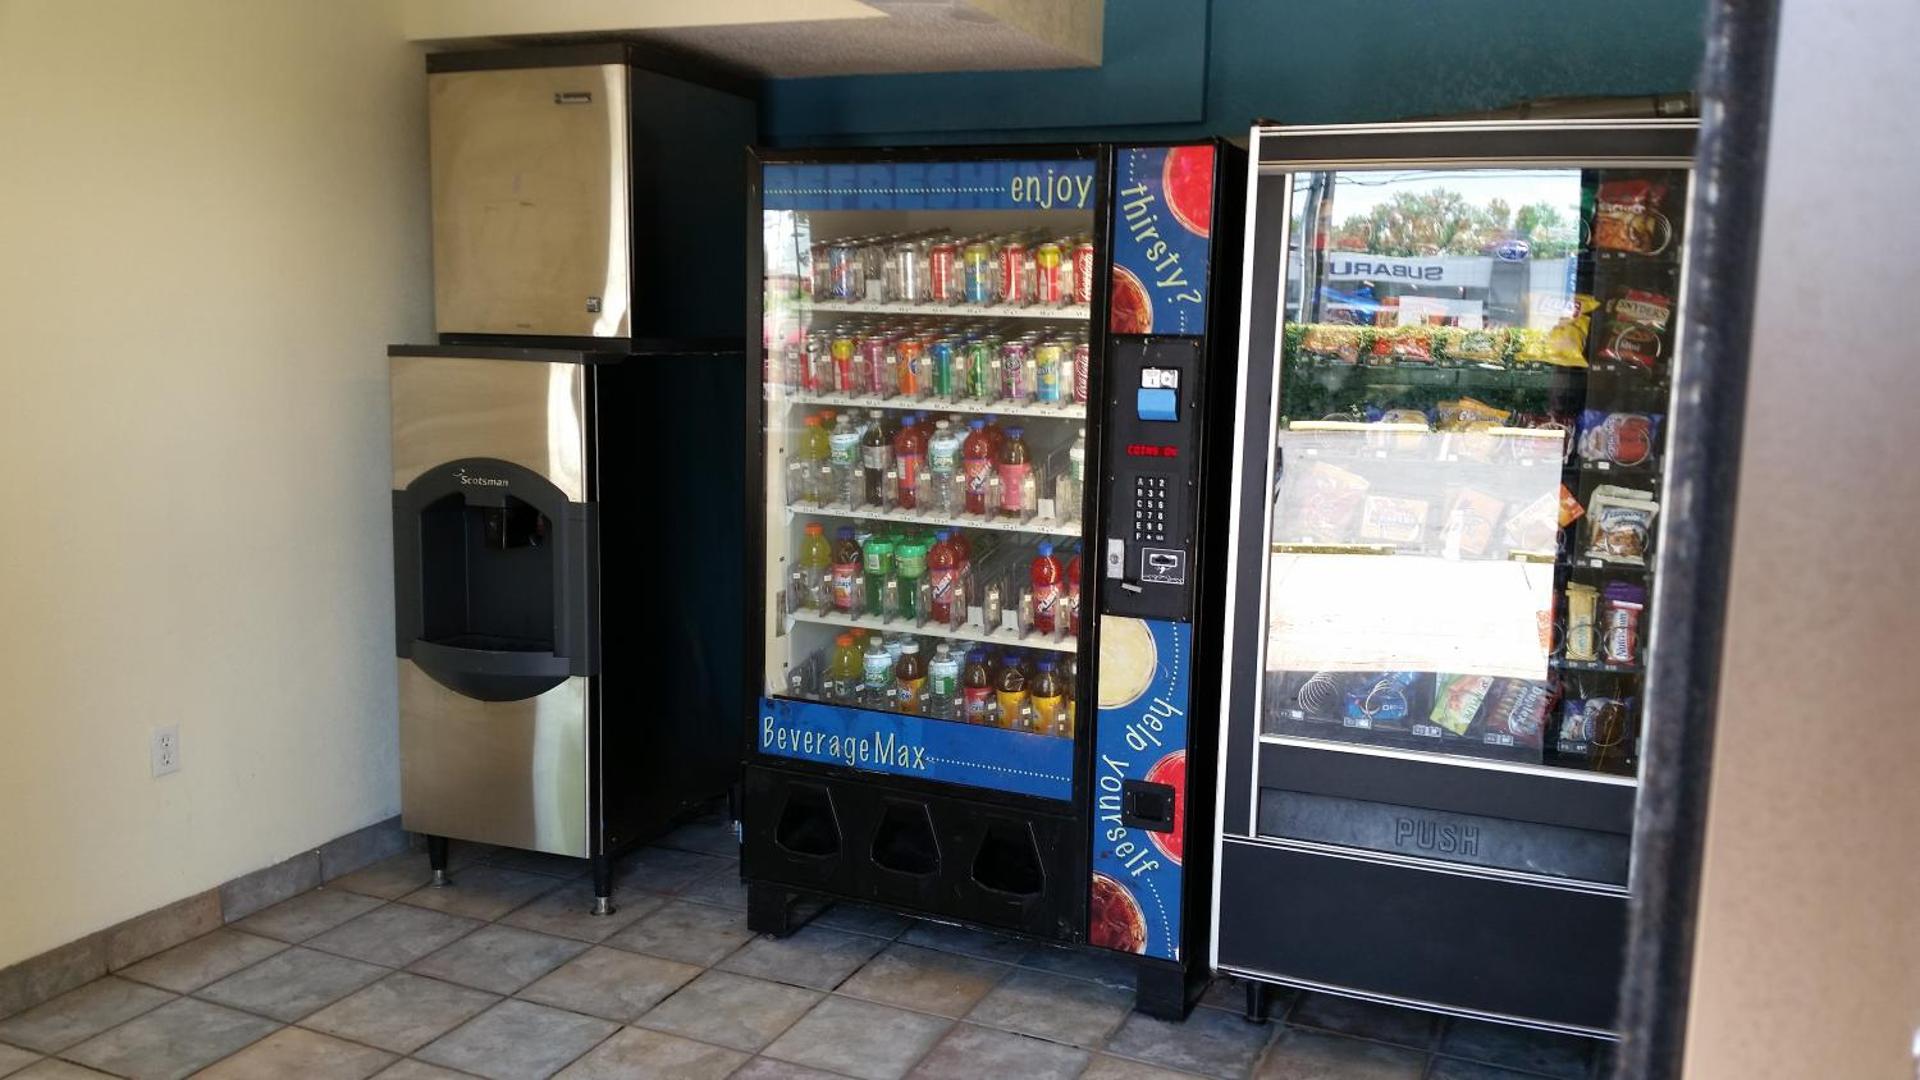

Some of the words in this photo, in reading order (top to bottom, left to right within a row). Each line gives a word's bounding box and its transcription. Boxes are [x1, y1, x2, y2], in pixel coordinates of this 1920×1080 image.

[1011, 169, 1093, 210] enjoy
[1120, 182, 1203, 305] thirsty?
[461, 475, 509, 487] Scotsman
[763, 716, 926, 770] BeverageMax
[1125, 697, 1184, 752] help
[1099, 754, 1159, 878] yourself
[1395, 818, 1480, 856] PUSH
